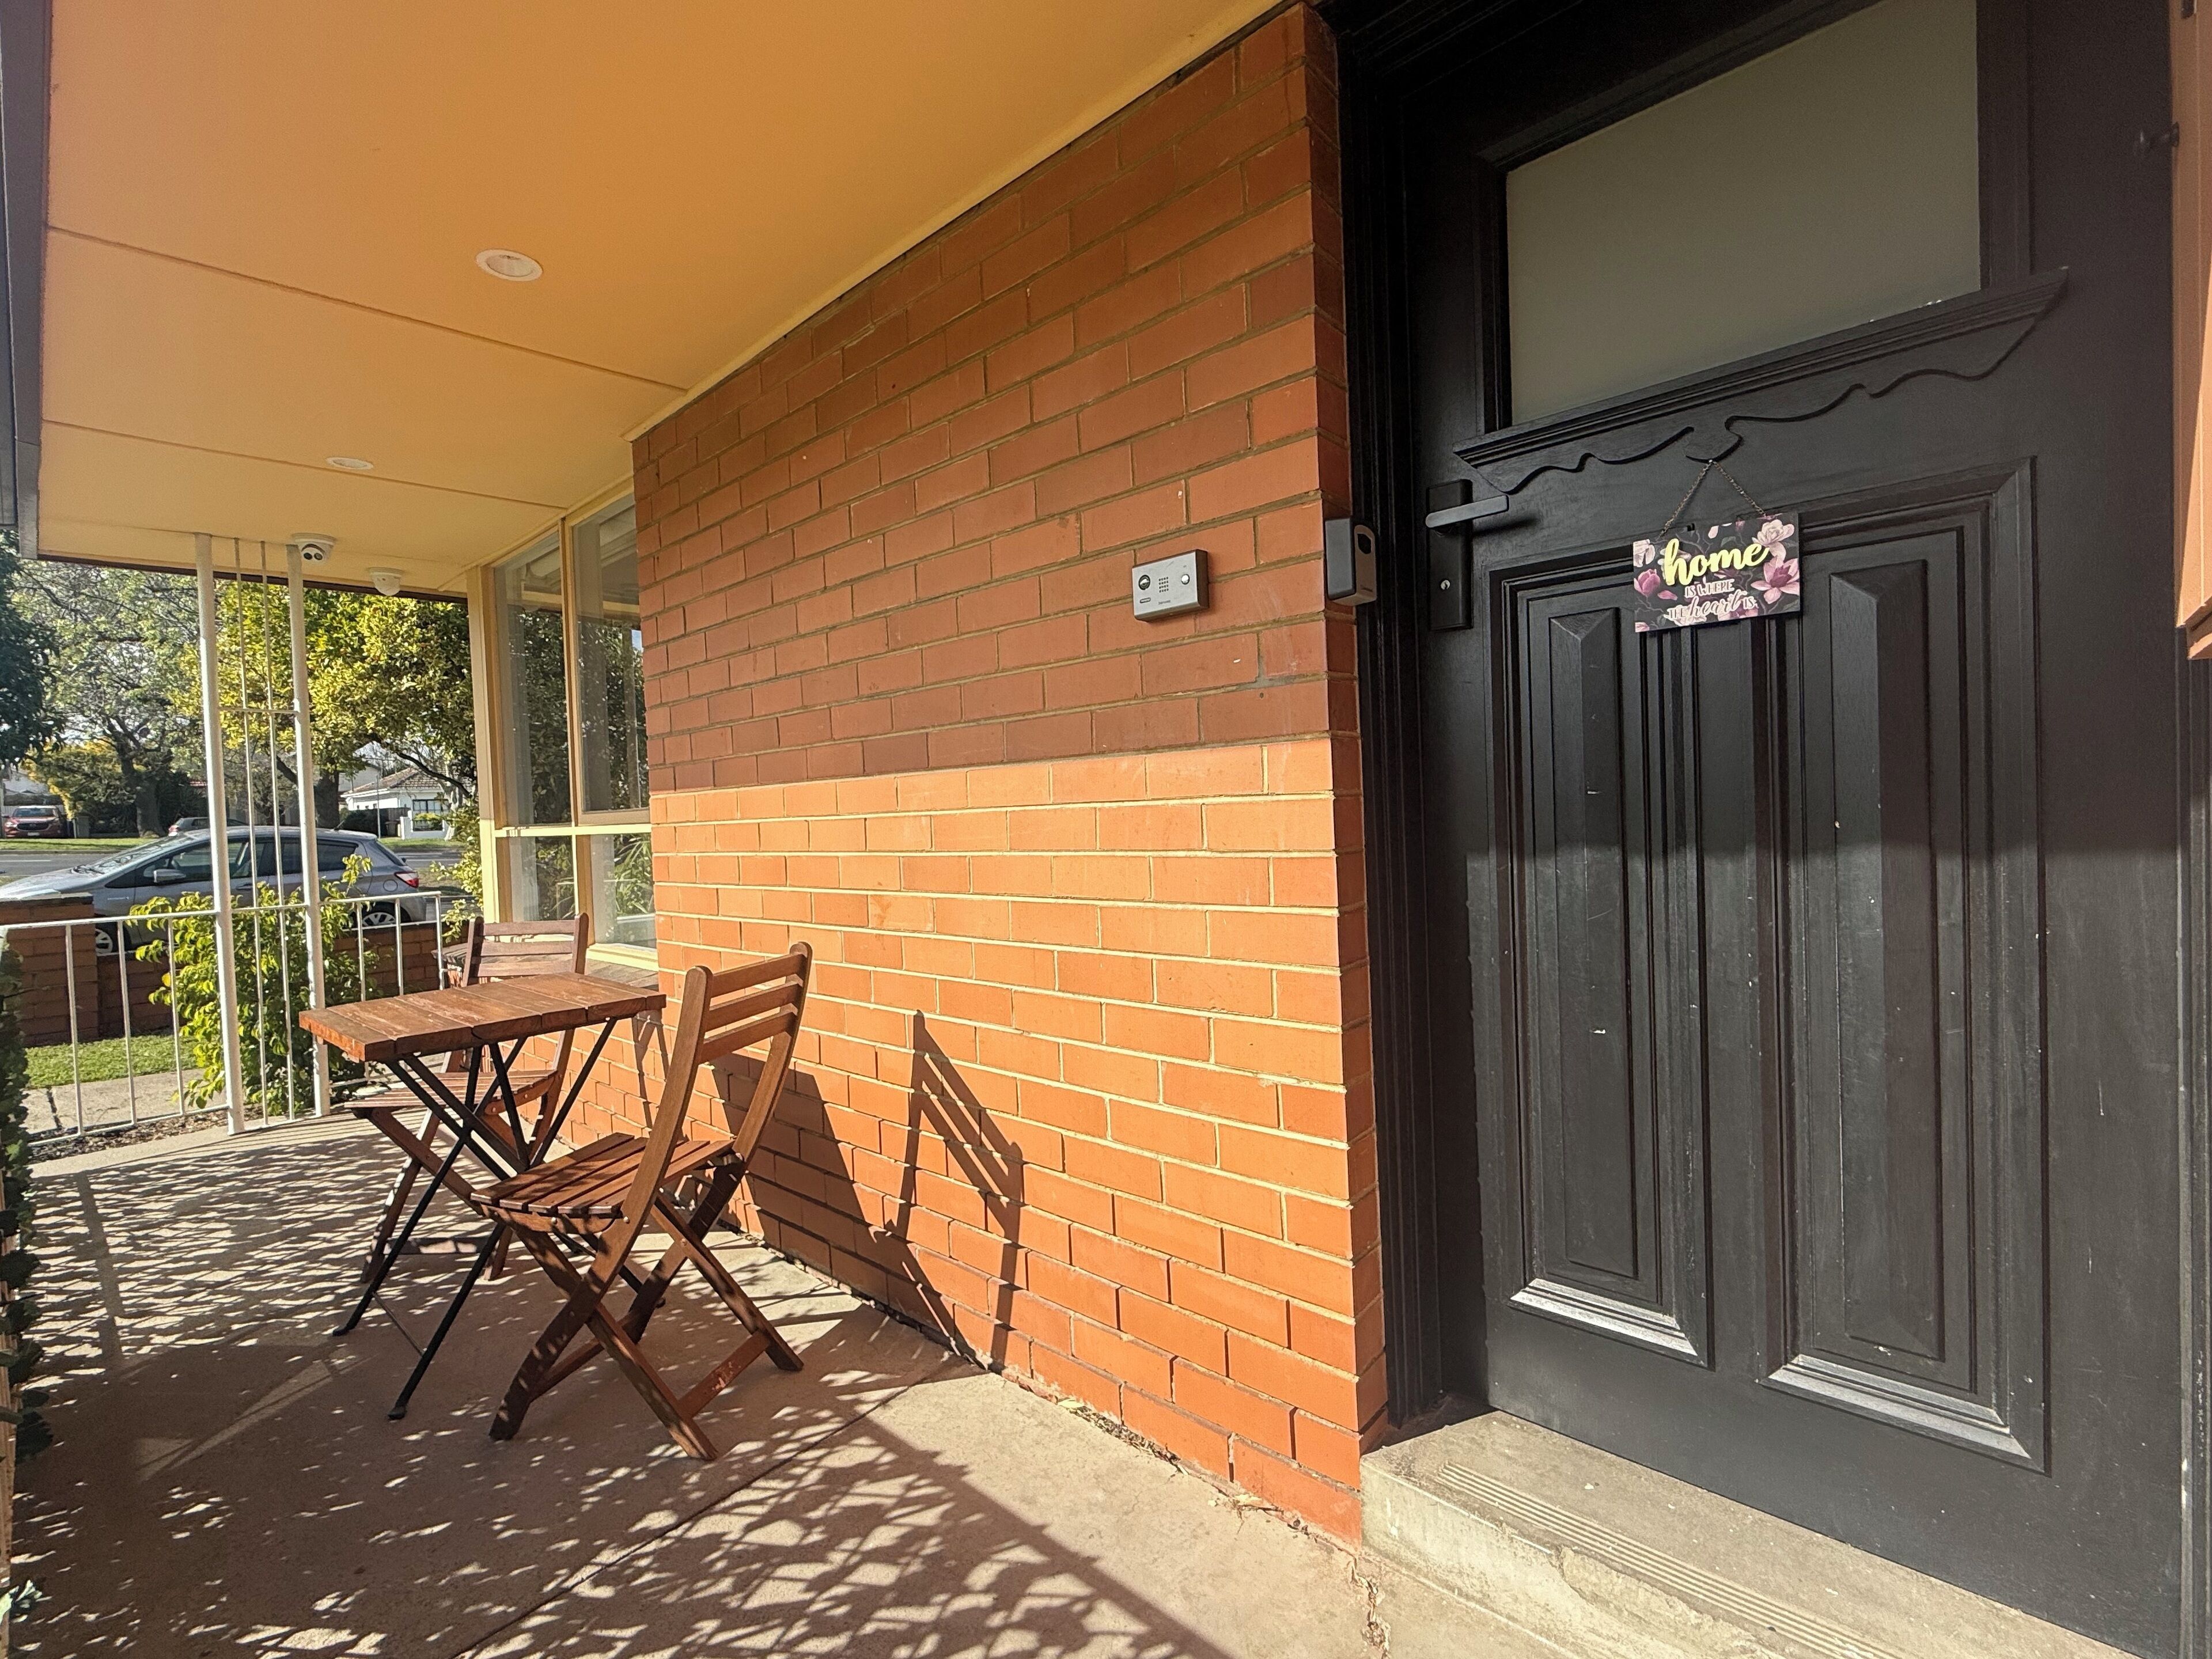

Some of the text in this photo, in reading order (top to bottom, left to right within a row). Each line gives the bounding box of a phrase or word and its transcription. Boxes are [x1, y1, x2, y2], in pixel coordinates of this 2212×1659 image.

[1664, 538, 1770, 586] home
[1685, 580, 1734, 597] IS WHERE
[1669, 590, 1755, 619] THE heart IS
